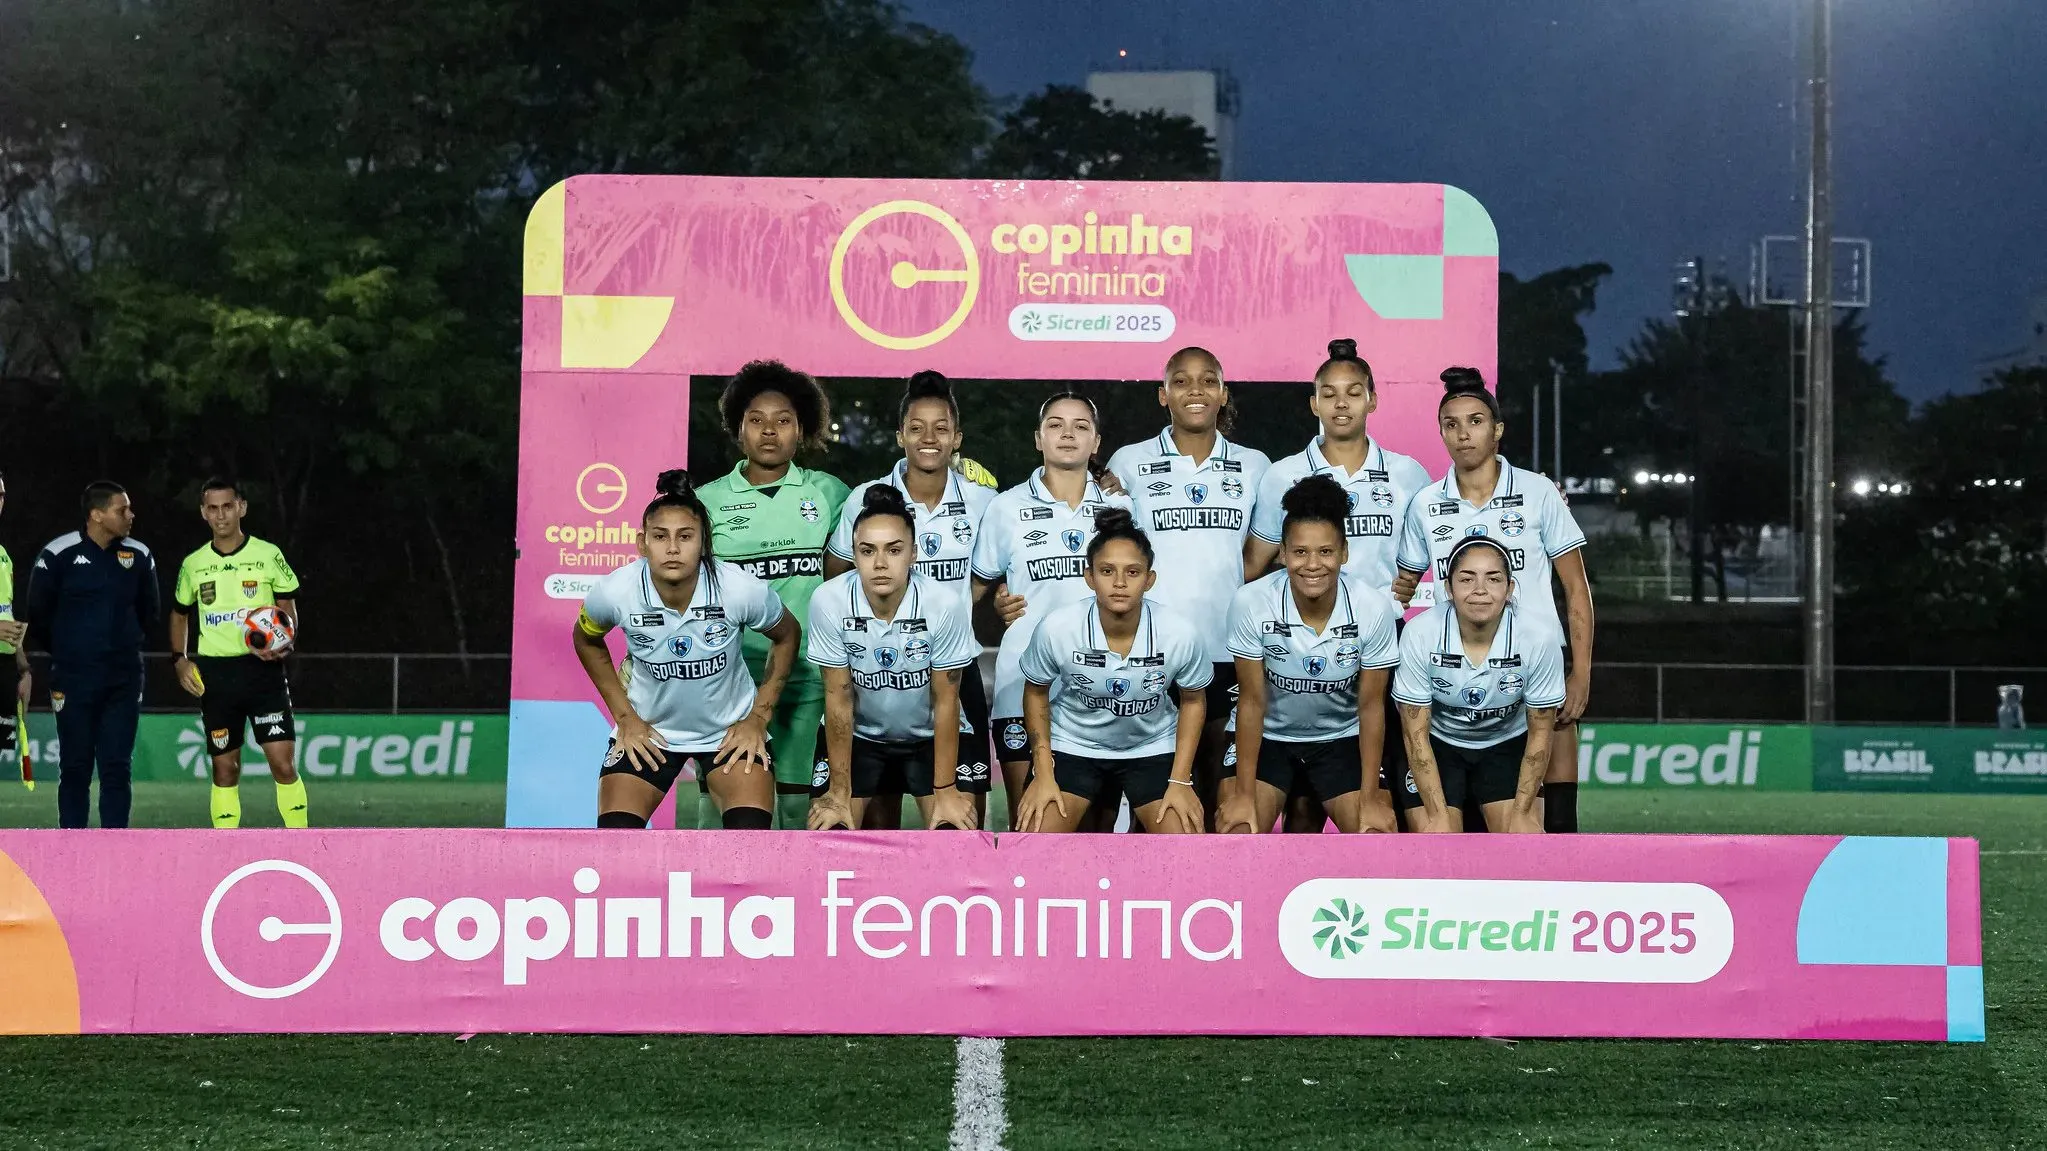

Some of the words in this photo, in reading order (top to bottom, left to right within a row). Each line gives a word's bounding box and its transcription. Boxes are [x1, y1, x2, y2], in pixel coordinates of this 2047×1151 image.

[992, 211, 1193, 265] copinha
[1018, 263, 1165, 297] feminina
[1046, 314, 1111, 331] Sicredi
[1116, 315, 1162, 331] 2025
[1154, 508, 1242, 534] MOSQUETEIRAS
[1344, 516, 1392, 535] ETEIRAS
[545, 520, 644, 549] copinh
[770, 538, 796, 548] arklok
[1026, 540, 1047, 548] umbro
[769, 559, 788, 575] DE
[791, 557, 822, 572] TODO
[1027, 556, 1089, 581] MOSQUET
[569, 582, 592, 593] Sicr
[205, 608, 250, 626] HiperC
[644, 652, 726, 680] OSQUETEIRAS
[1577, 728, 1762, 785] icredi
[1844, 749, 1934, 773] BRASIL
[1974, 750, 2047, 774] BRASI
[379, 867, 795, 986] copinha
[821, 870, 1243, 961] feminina
[1381, 906, 1560, 952] Sicredi
[1572, 910, 1697, 954] 2025
